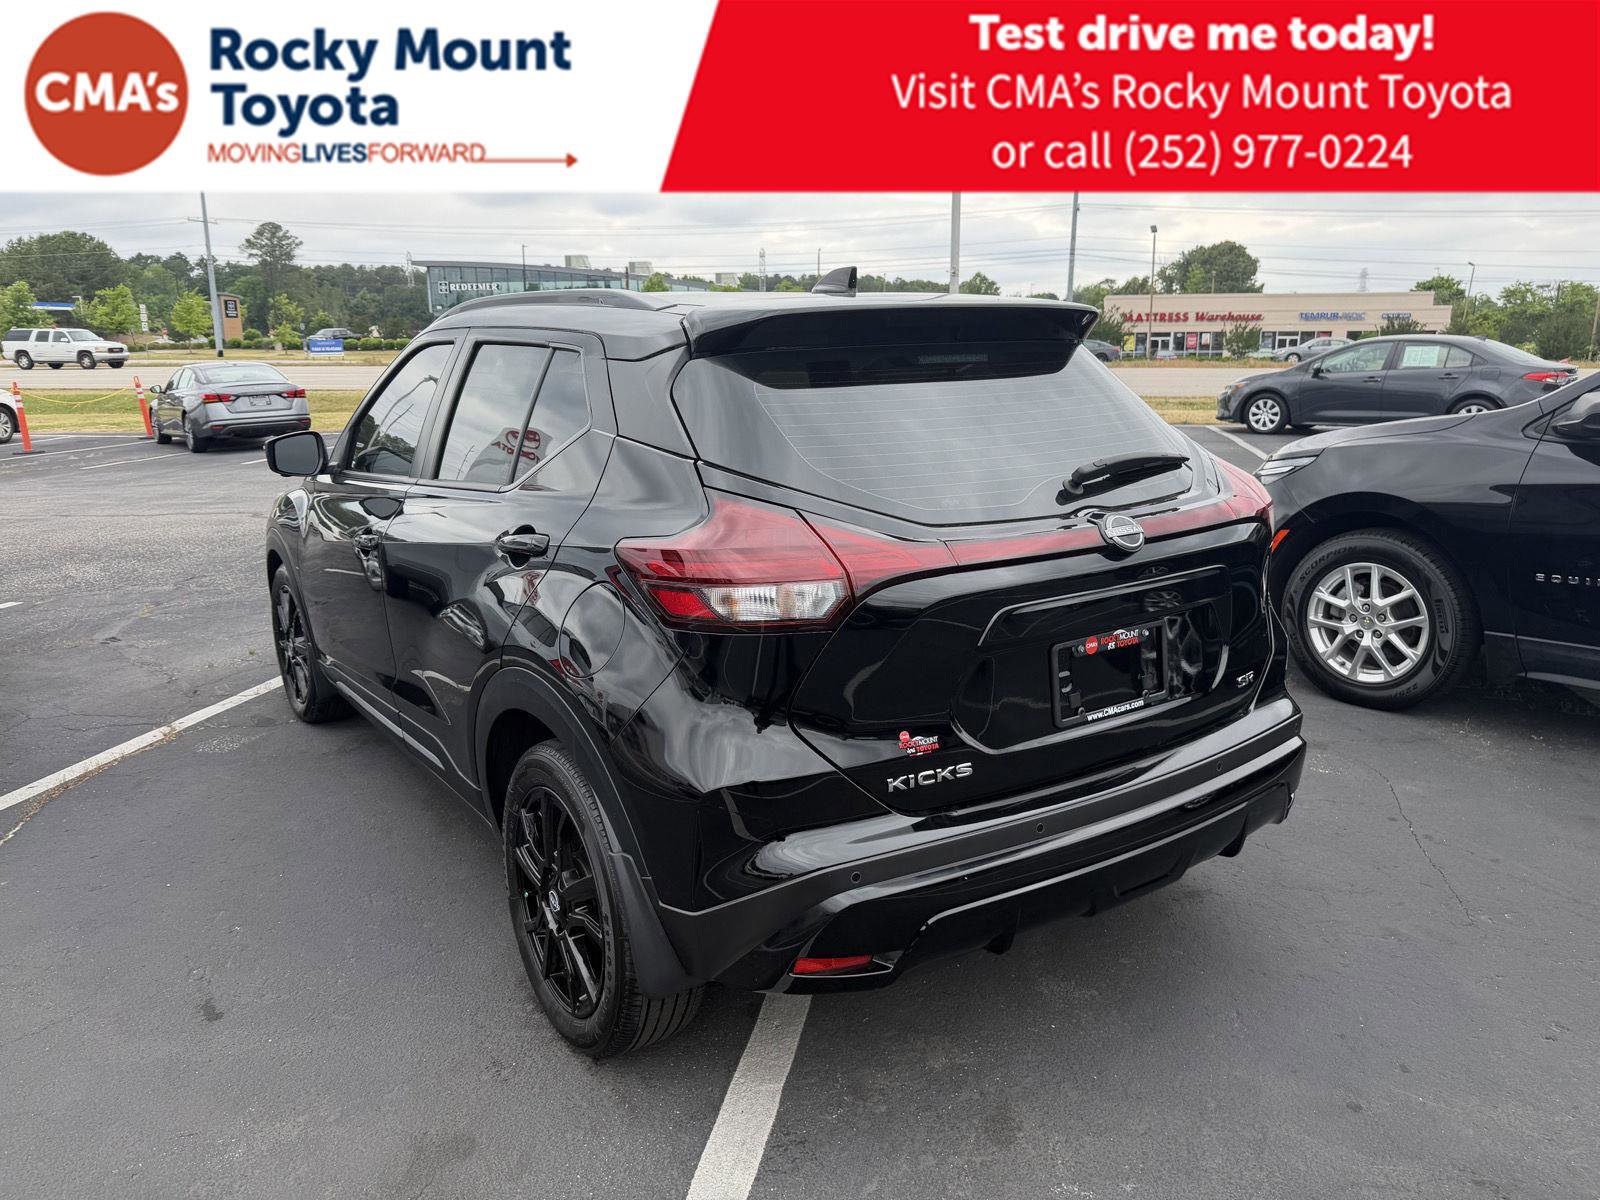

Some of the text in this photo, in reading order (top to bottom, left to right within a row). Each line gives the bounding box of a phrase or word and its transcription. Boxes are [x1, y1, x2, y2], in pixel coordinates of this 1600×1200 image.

[1195, 311, 1263, 322] Warehouse
[1086, 700, 1144, 721] www.CMAcars.com
[886, 762, 973, 793] KICKS
